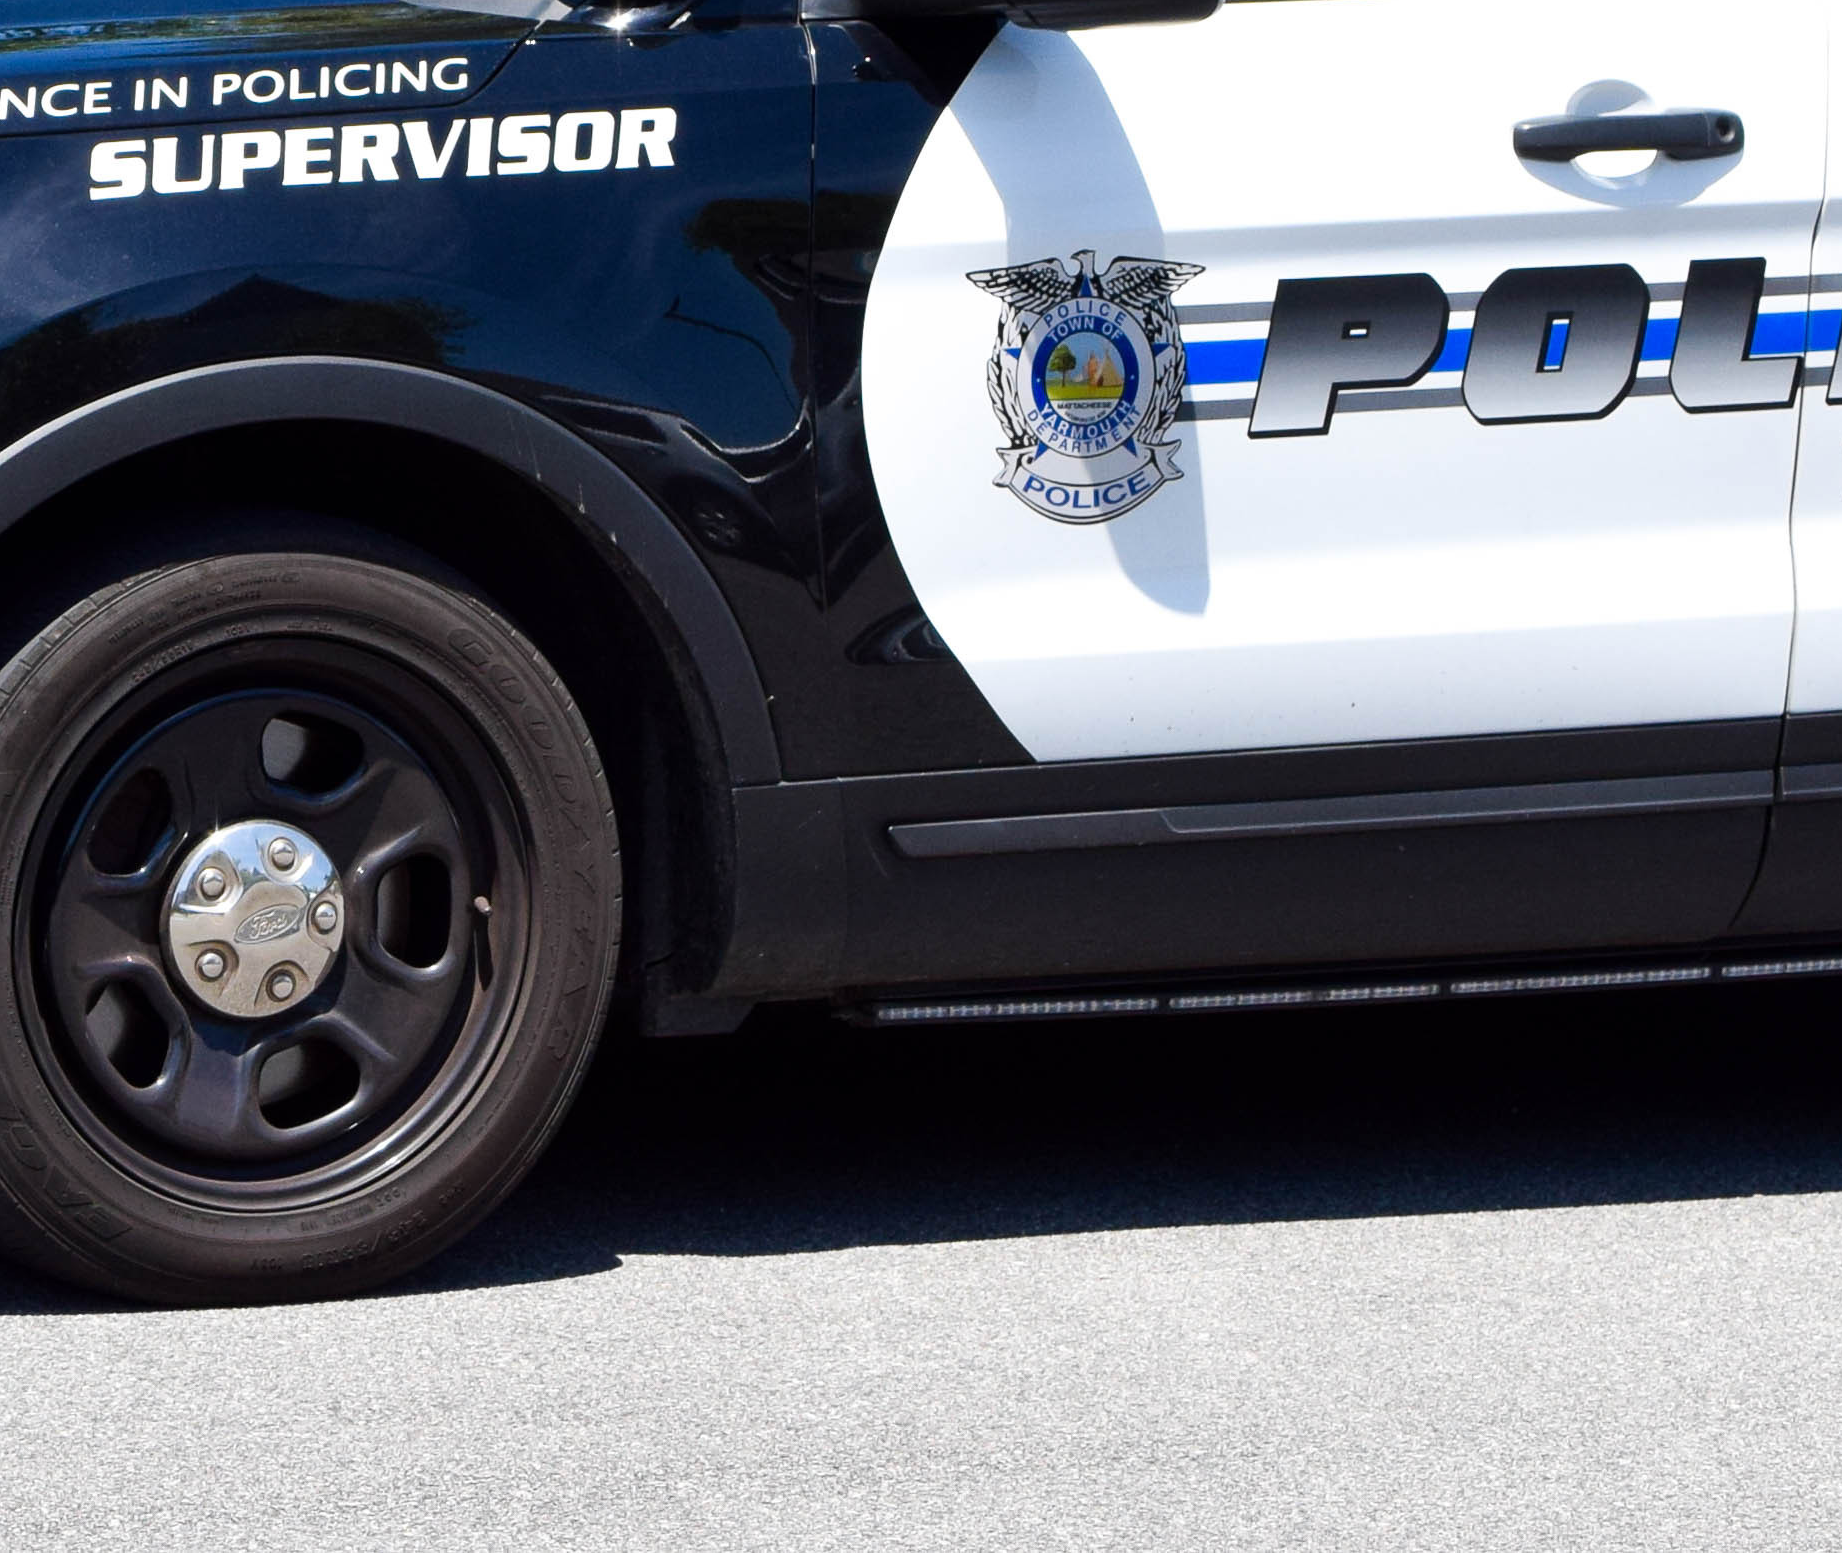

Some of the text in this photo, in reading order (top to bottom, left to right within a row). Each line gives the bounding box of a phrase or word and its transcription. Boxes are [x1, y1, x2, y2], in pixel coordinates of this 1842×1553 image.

[134, 76, 187, 111] IN
[211, 56, 470, 106] POLICING
[89, 107, 679, 201] SUPERVISOR
[1044, 301, 1127, 328] POLICE
[1047, 317, 1124, 343] TOWN OF
[1027, 405, 1140, 453] DEPARTMENT
[1041, 401, 1131, 439] YARMOUTH
[1023, 471, 1151, 509] POLICE
[249, 911, 289, 939] Ford
